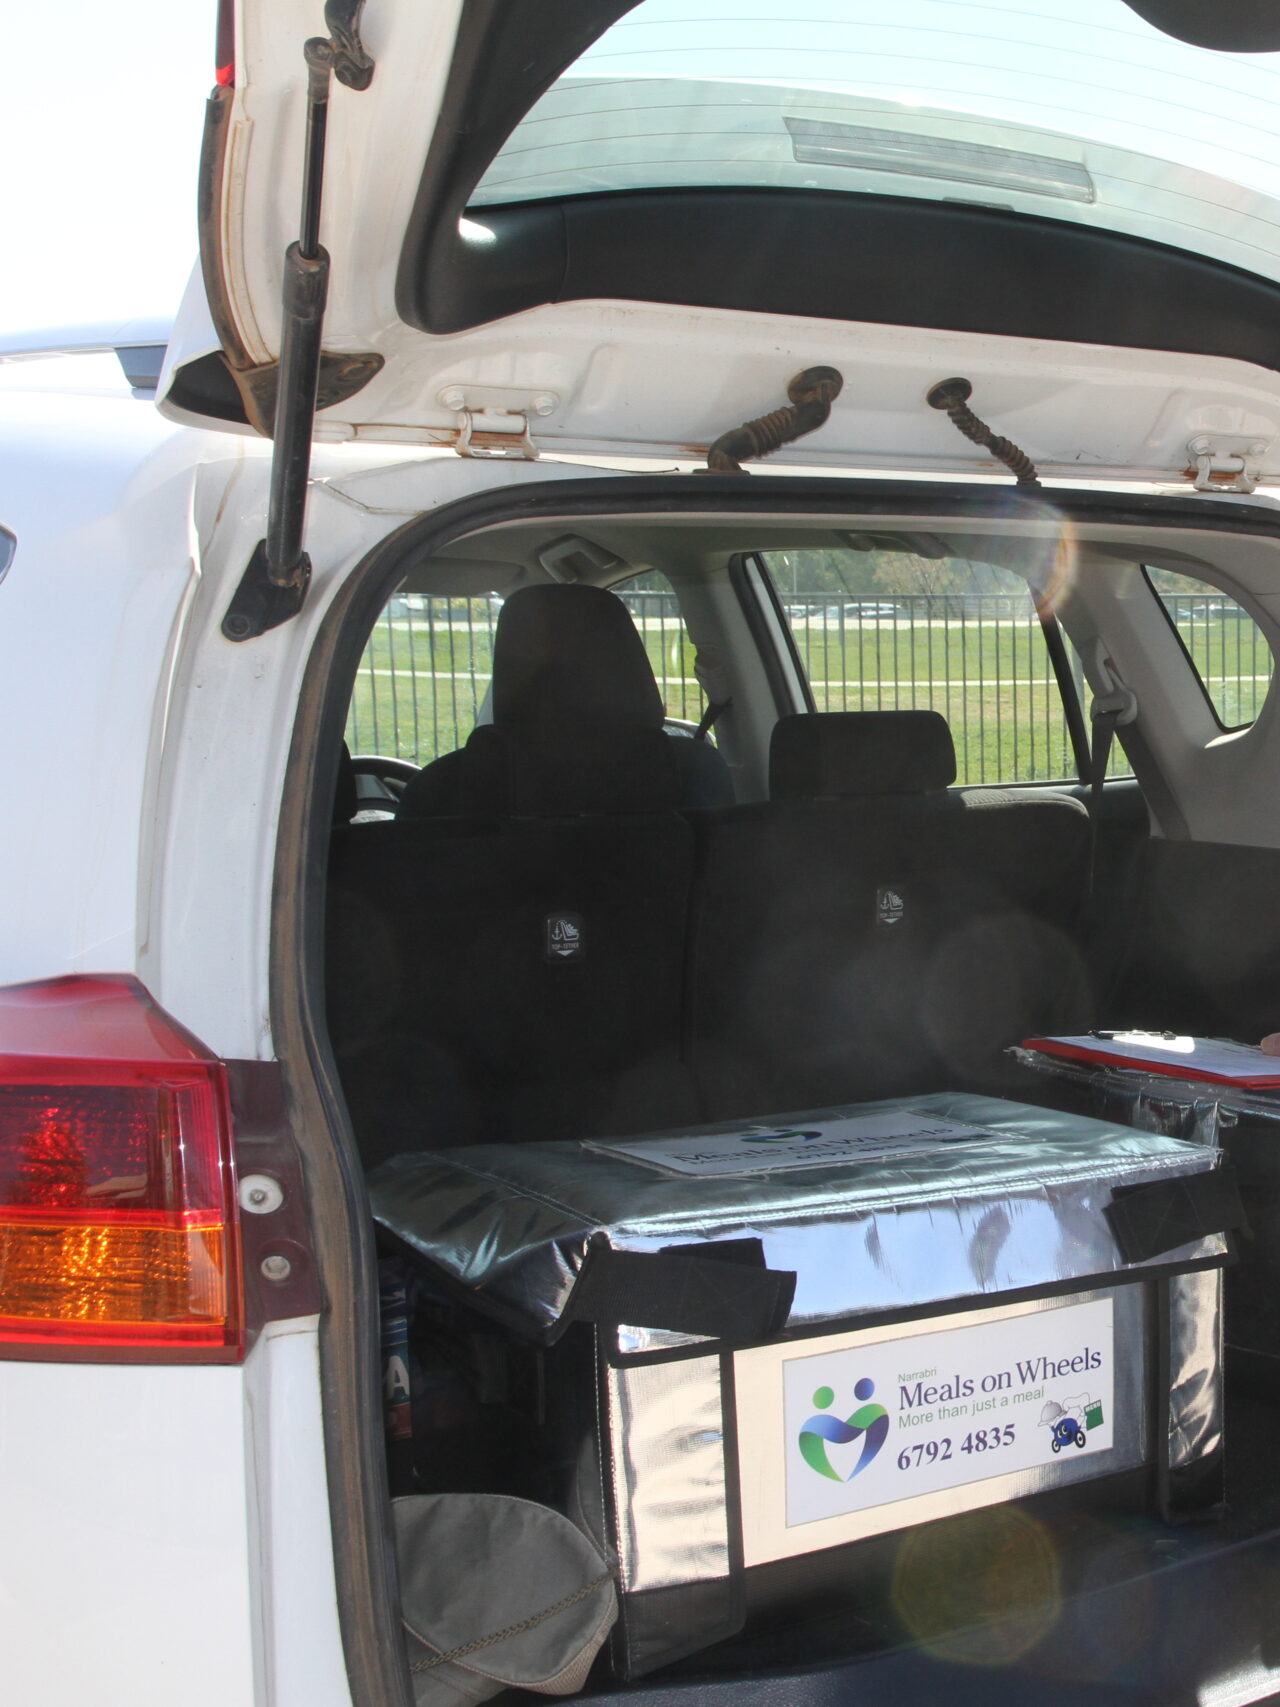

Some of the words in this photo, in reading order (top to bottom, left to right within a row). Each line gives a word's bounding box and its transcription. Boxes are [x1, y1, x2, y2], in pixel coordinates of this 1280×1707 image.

[898, 1366, 938, 1383] Narrabri
[899, 1374, 976, 1411] Meals
[981, 1371, 1012, 1393] on
[1016, 1347, 1102, 1385] Wheels
[898, 1412, 934, 1429] More
[938, 1404, 968, 1420] than
[971, 1396, 997, 1417] just
[1000, 1396, 1009, 1406] a
[1013, 1385, 1045, 1405] meal
[897, 1437, 953, 1471] 6792
[960, 1423, 1016, 1454] 4835
